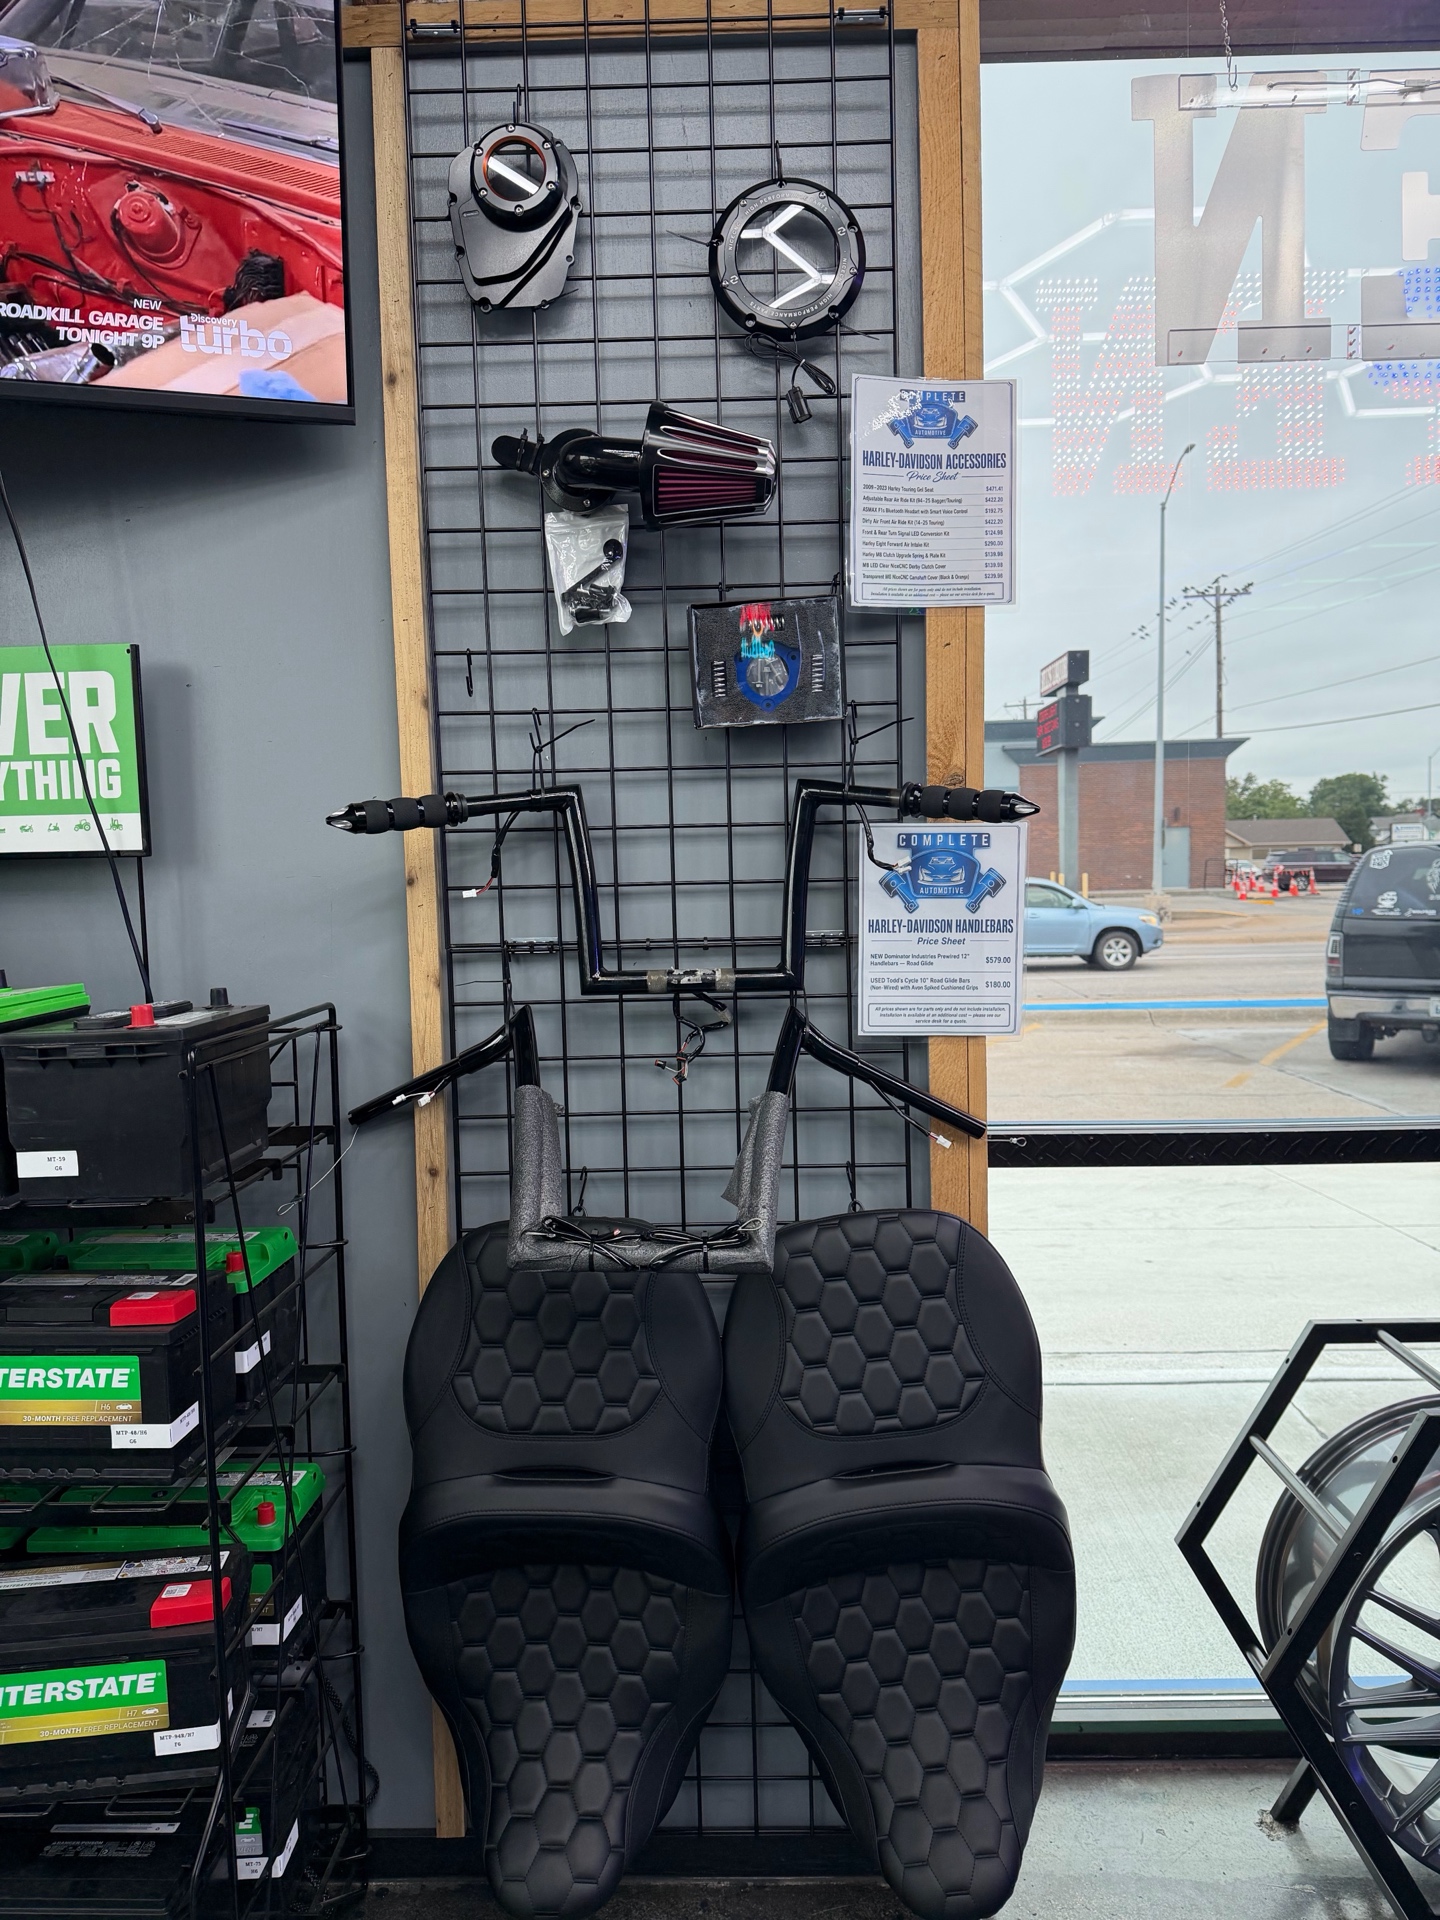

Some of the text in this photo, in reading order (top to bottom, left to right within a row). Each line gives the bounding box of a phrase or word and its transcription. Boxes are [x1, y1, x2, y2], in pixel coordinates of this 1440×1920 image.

[744, 202, 758, 215] HIGH
[134, 298, 162, 311] NEW
[819, 293, 833, 306] HIGH
[0, 302, 164, 331] ROADKILL GARAGE
[190, 312, 238, 327] Discovery
[56, 326, 166, 350] TONIGHT 9P
[180, 314, 294, 361] turbo
[901, 390, 965, 402] PLETE
[862, 450, 1007, 470] HARLEY-DAVIDSON ACCESSORIES
[906, 470, 958, 483] Price Sheet
[900, 834, 990, 846] COMPLETE
[920, 887, 964, 895] AUTOMOTIVE
[868, 919, 1014, 934] HARLEY-DAVIDSON HANDLEBARS
[917, 937, 966, 945] Price Sheet
[39, 1719, 159, 1738] 30-MONTH FREE REPLACEMENT
